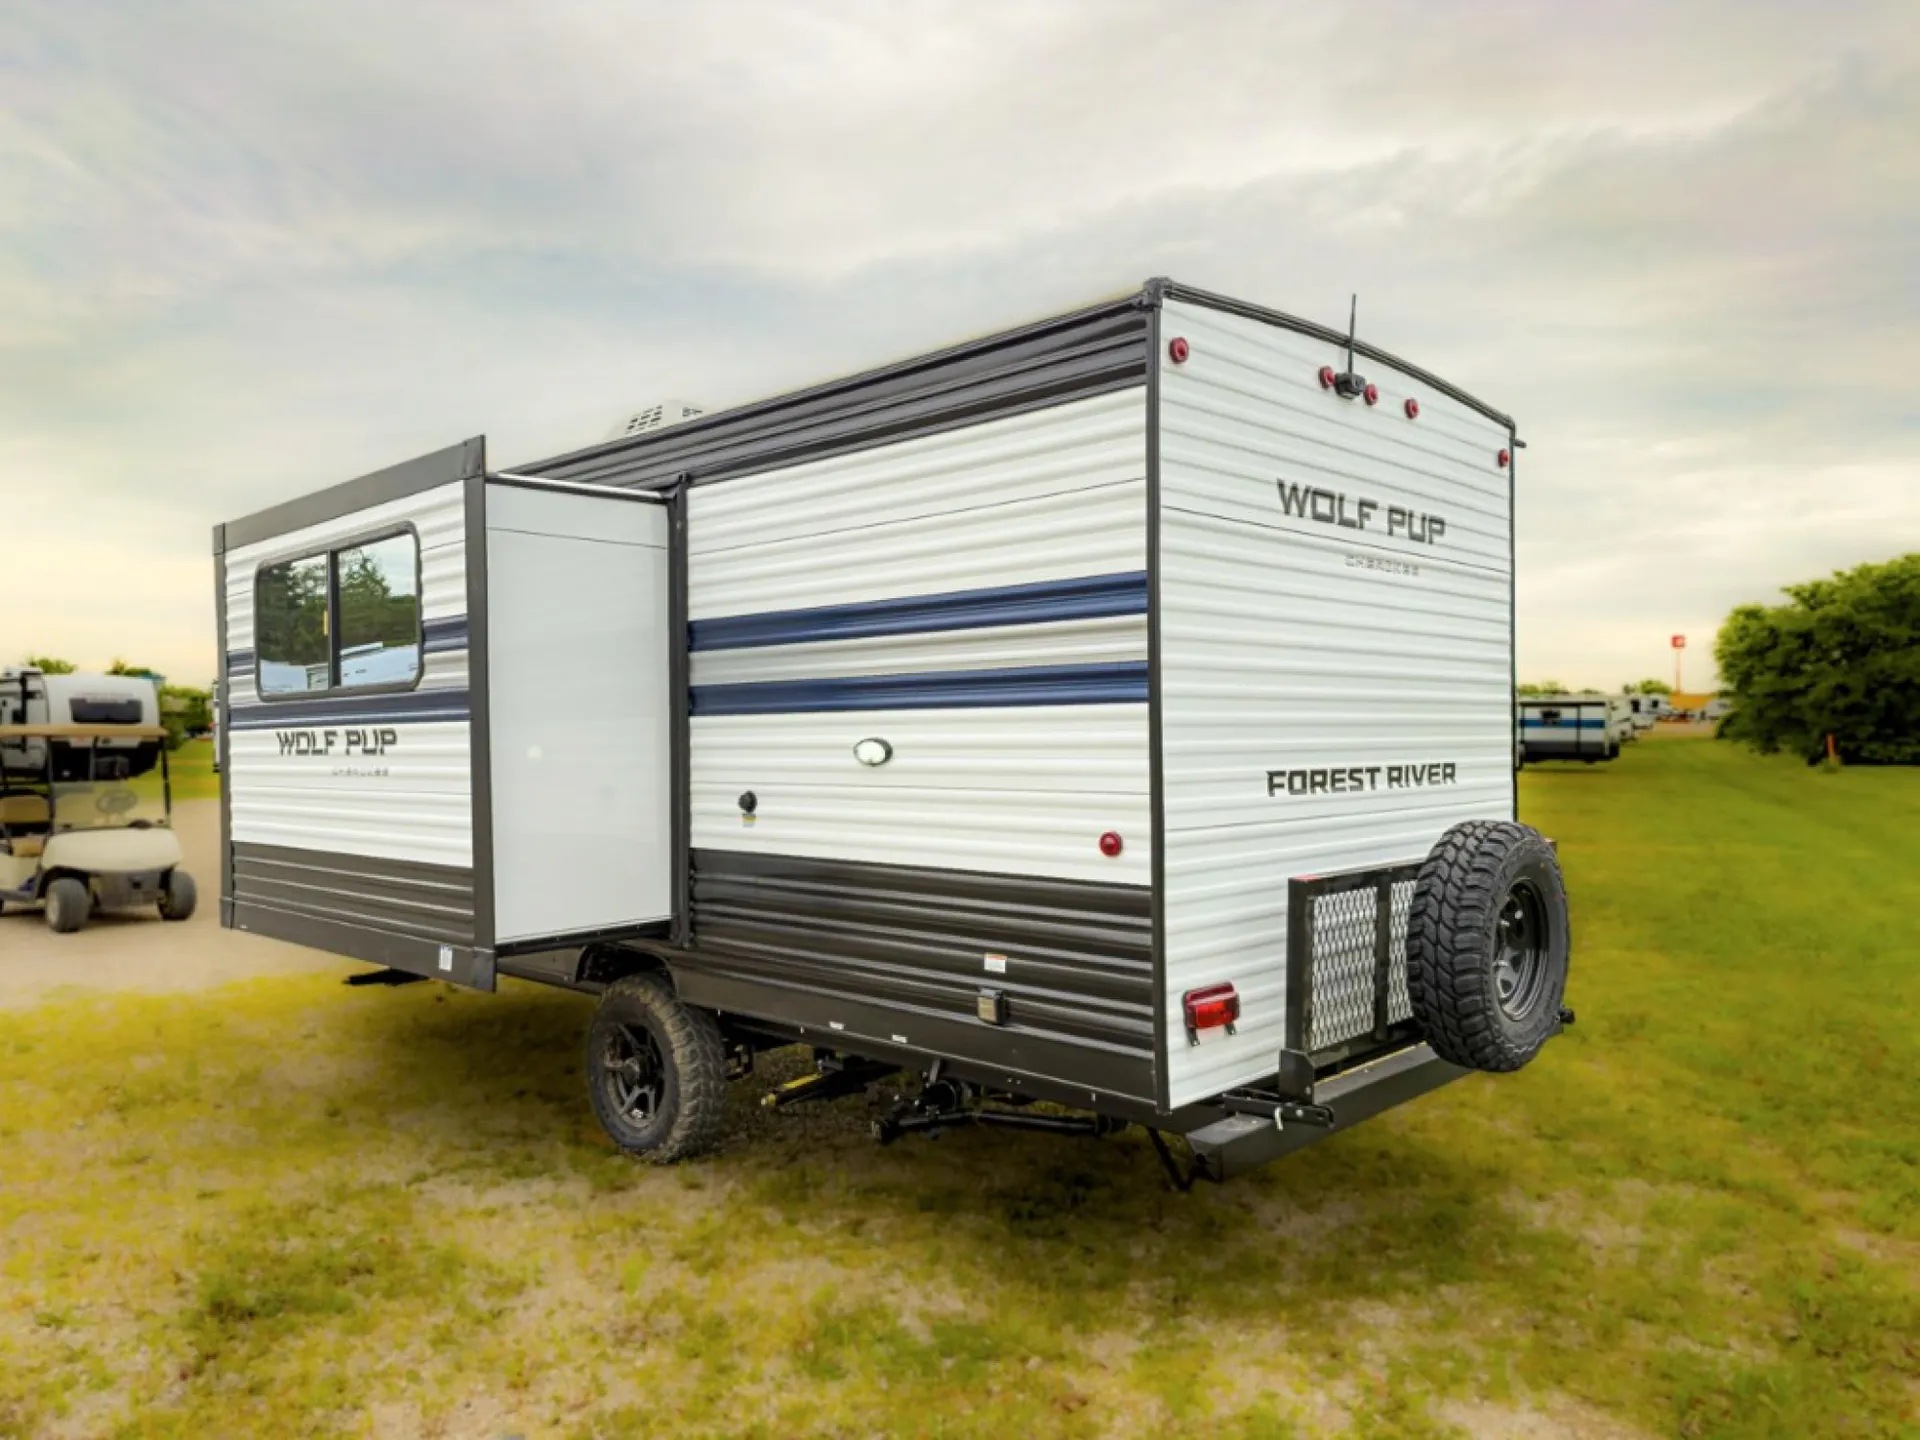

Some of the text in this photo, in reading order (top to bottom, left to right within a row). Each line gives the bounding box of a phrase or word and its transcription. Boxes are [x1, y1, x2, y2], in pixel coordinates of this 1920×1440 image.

[1276, 477, 1446, 545] WOLF PUP
[275, 728, 397, 756] WOLF PUP
[1266, 762, 1456, 798] FOREST RIVER
